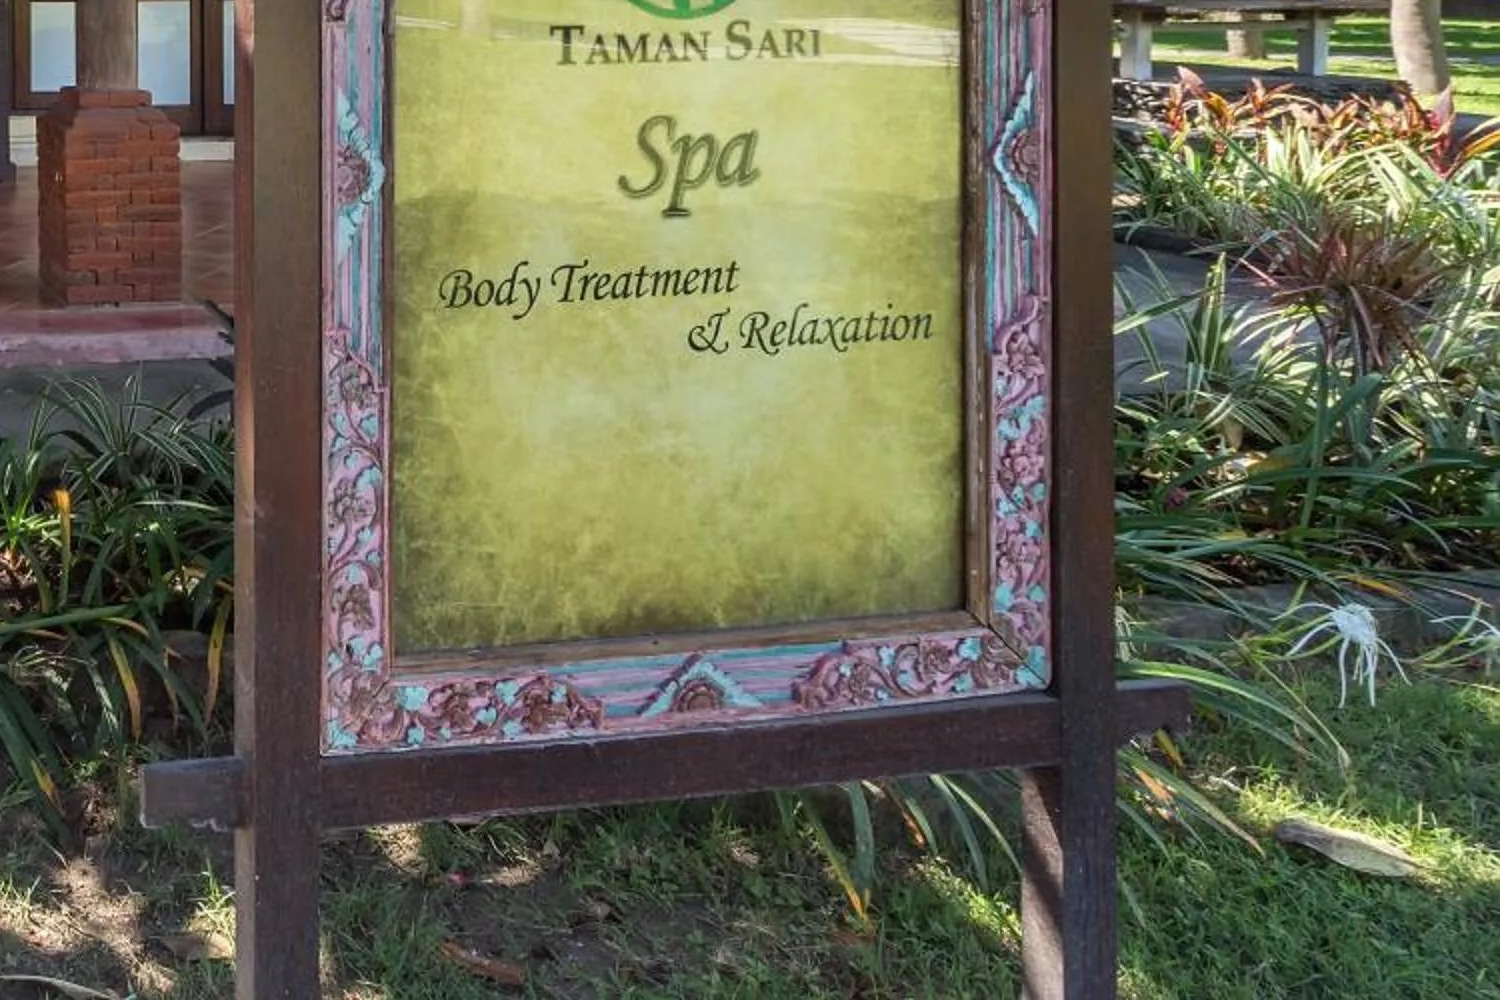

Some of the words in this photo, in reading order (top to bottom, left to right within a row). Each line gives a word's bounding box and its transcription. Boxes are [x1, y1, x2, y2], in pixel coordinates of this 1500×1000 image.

[549, 25, 711, 65] TAMAN
[724, 20, 822, 61] SARI
[618, 116, 760, 218] Spa
[438, 261, 542, 319] Body
[551, 259, 741, 304] Treatment
[687, 308, 730, 354] &
[741, 303, 933, 355] Relaxation
